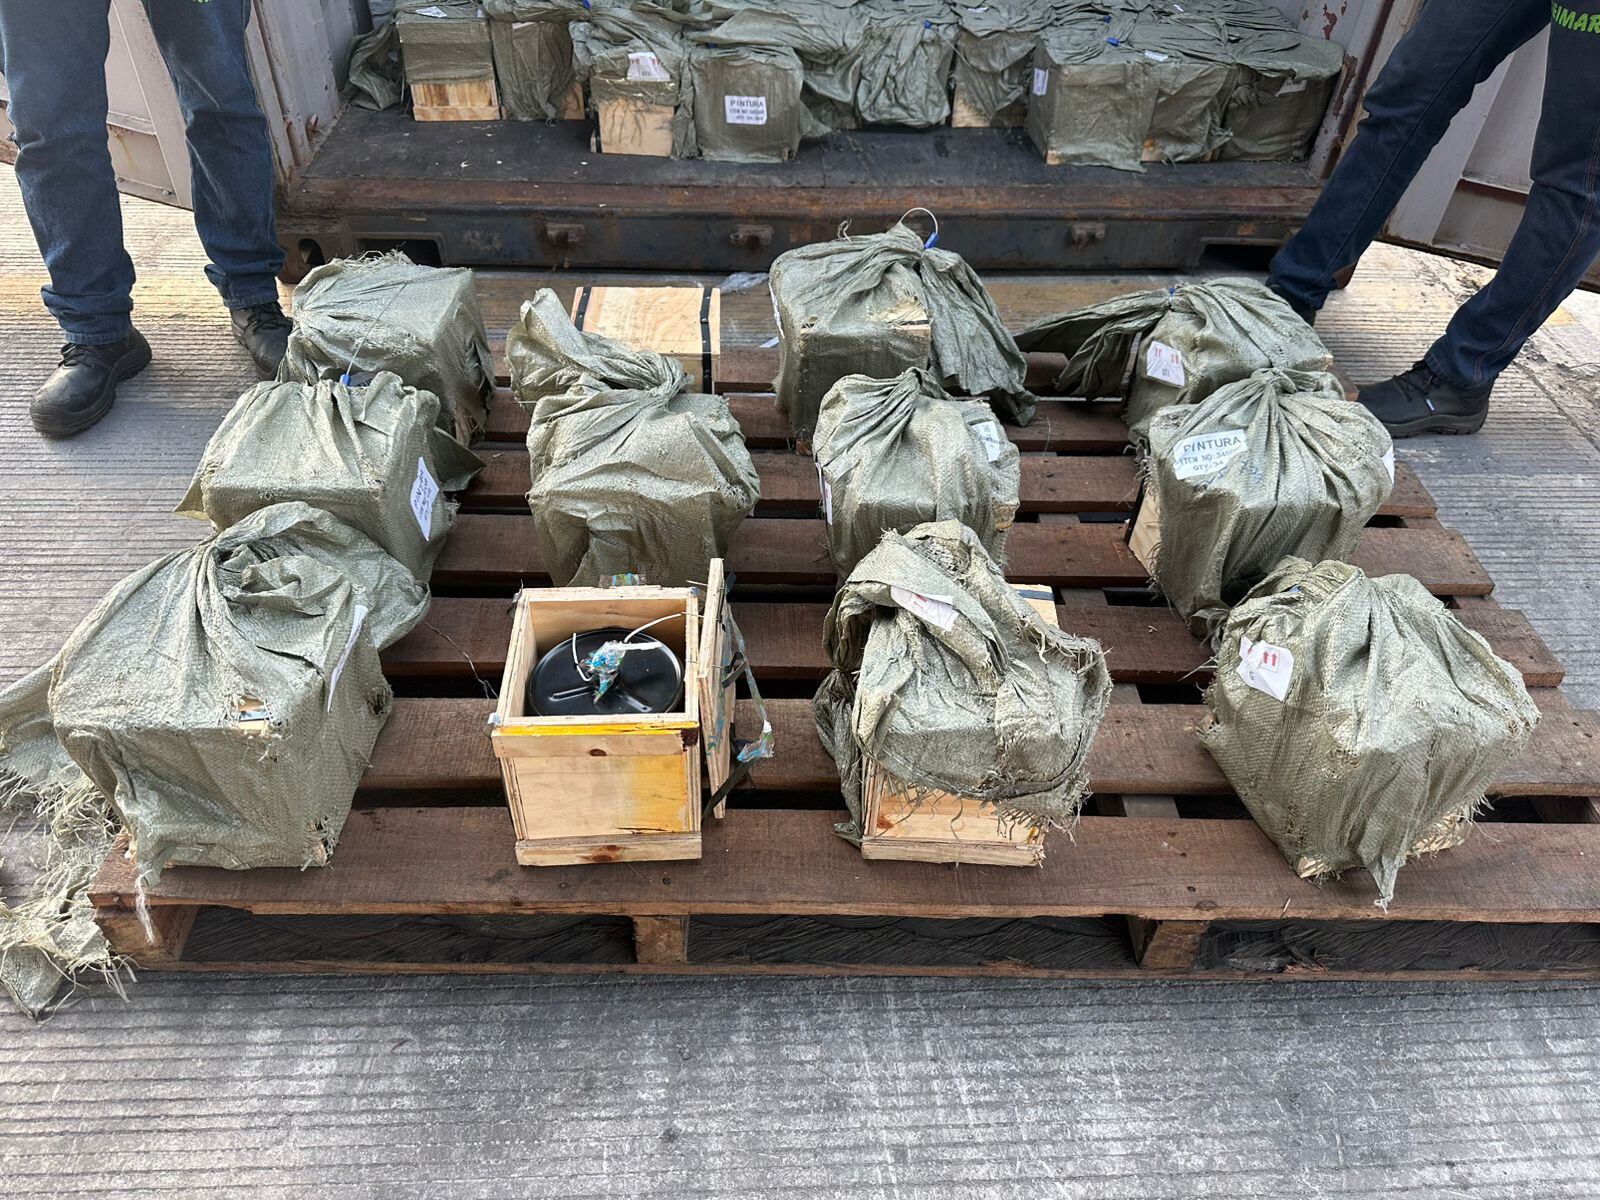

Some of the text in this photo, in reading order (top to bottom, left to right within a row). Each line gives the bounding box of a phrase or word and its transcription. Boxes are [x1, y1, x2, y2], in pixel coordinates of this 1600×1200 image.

[730, 99, 764, 108] PINTURA
[1183, 436, 1242, 453] PINTURA
[1179, 455, 1198, 466] ITEM
